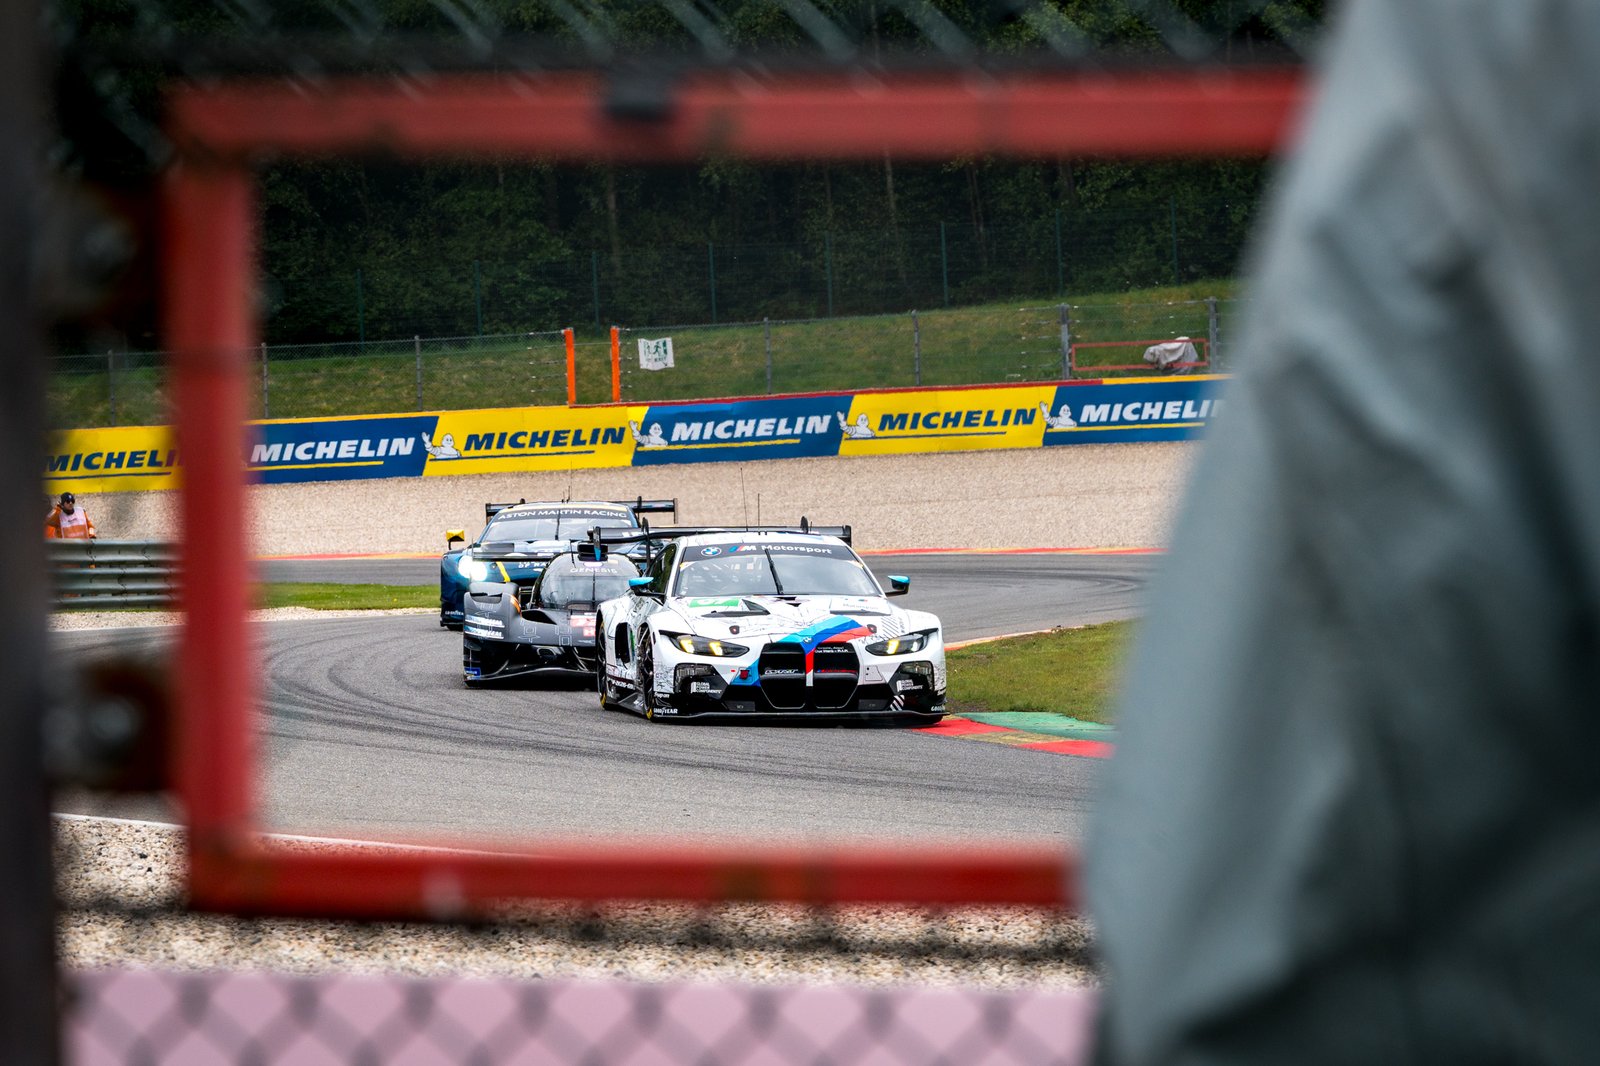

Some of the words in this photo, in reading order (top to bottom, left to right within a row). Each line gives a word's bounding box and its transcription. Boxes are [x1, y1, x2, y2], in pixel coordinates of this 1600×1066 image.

[671, 414, 832, 442] MICHELIN
[878, 408, 1037, 431] MICHELIN
[250, 437, 416, 463] MICHELIN
[464, 427, 626, 451] MICHELIN
[44, 449, 182, 472] MICHELI
[497, 511, 536, 520] ASTON
[583, 509, 627, 518] RACING
[760, 545, 833, 555] Motorsport
